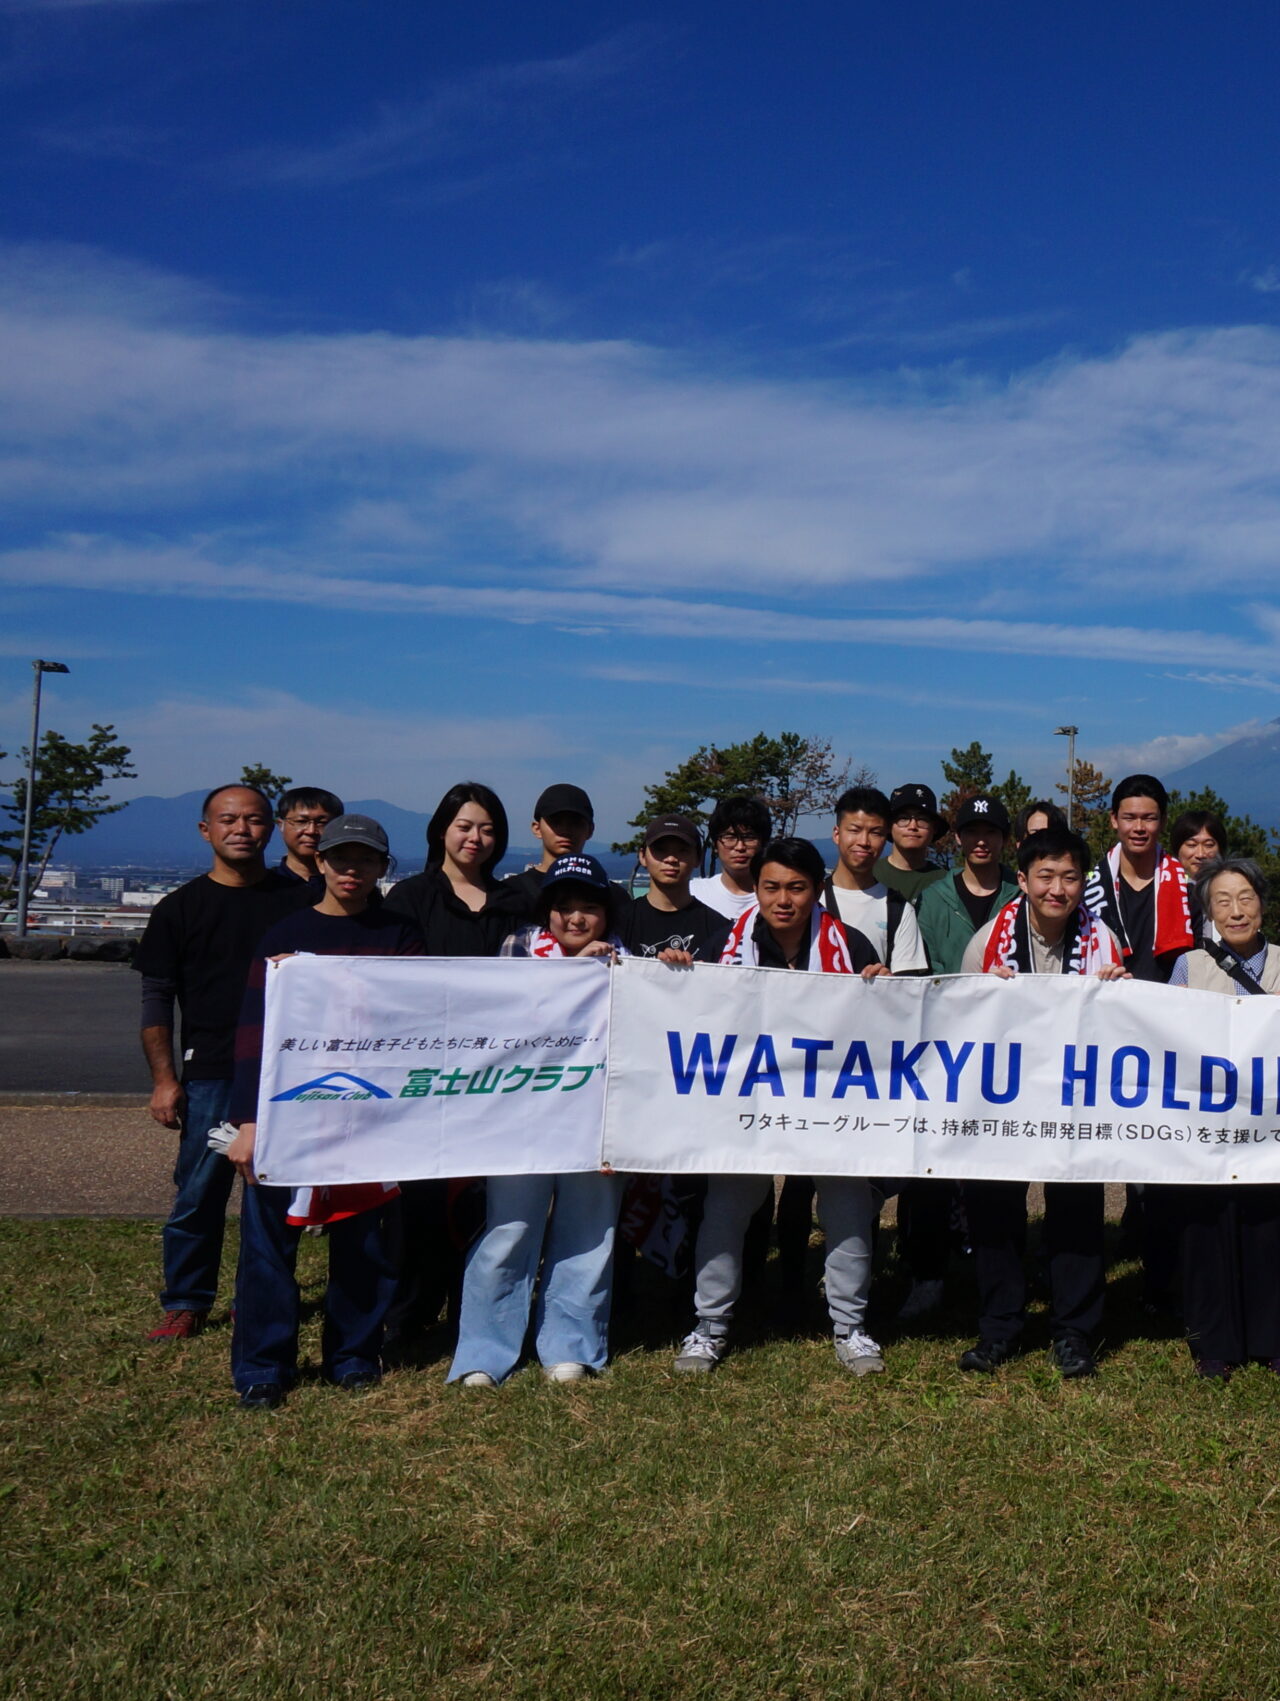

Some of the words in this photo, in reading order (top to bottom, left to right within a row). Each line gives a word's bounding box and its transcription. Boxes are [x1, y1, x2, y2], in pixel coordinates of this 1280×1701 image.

[554, 866, 593, 877] HILFIGER
[557, 857, 592, 866] TOMMY
[667, 1030, 1022, 1106] WATAKYU
[399, 1062, 606, 1099] 富士山クラブ
